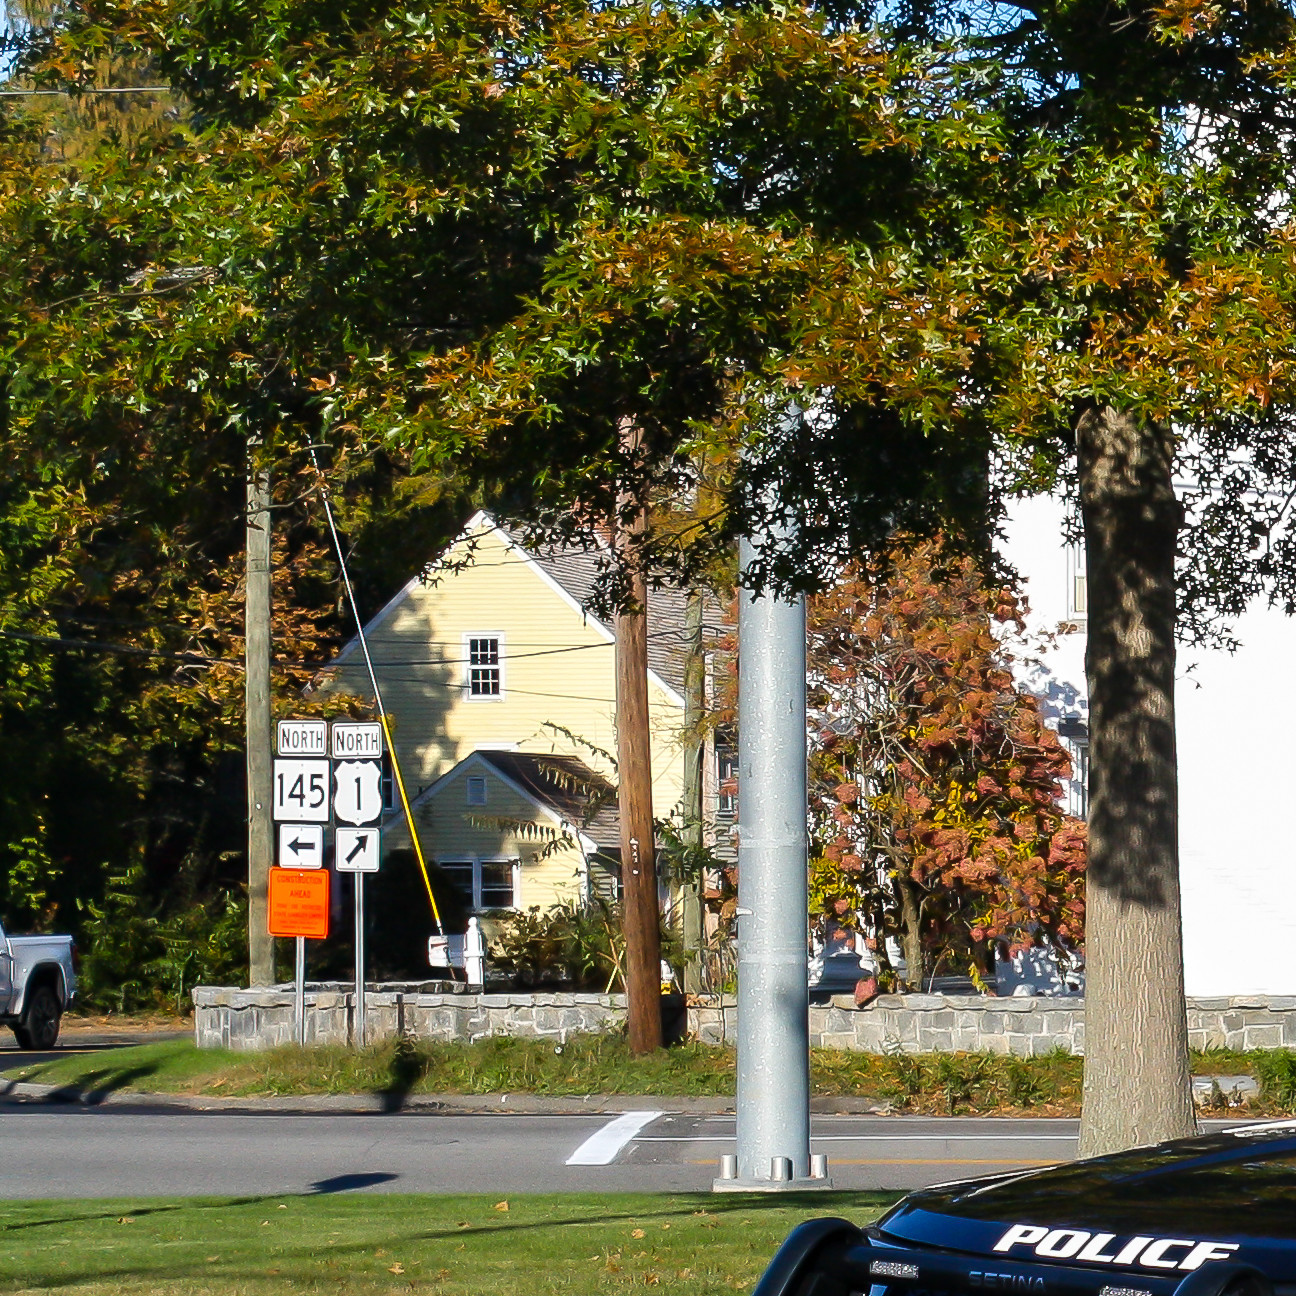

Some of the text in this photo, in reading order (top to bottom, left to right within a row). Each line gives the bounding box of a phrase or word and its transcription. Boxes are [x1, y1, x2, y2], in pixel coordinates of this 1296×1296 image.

[281, 728, 323, 748] NORTH
[336, 731, 378, 751] NORTH
[278, 773, 325, 808] 145
[354, 776, 361, 811] 1
[276, 875, 322, 884] CONSTRUCTION
[289, 889, 311, 898] AHEAD
[969, 1270, 1047, 1292] SETINA
